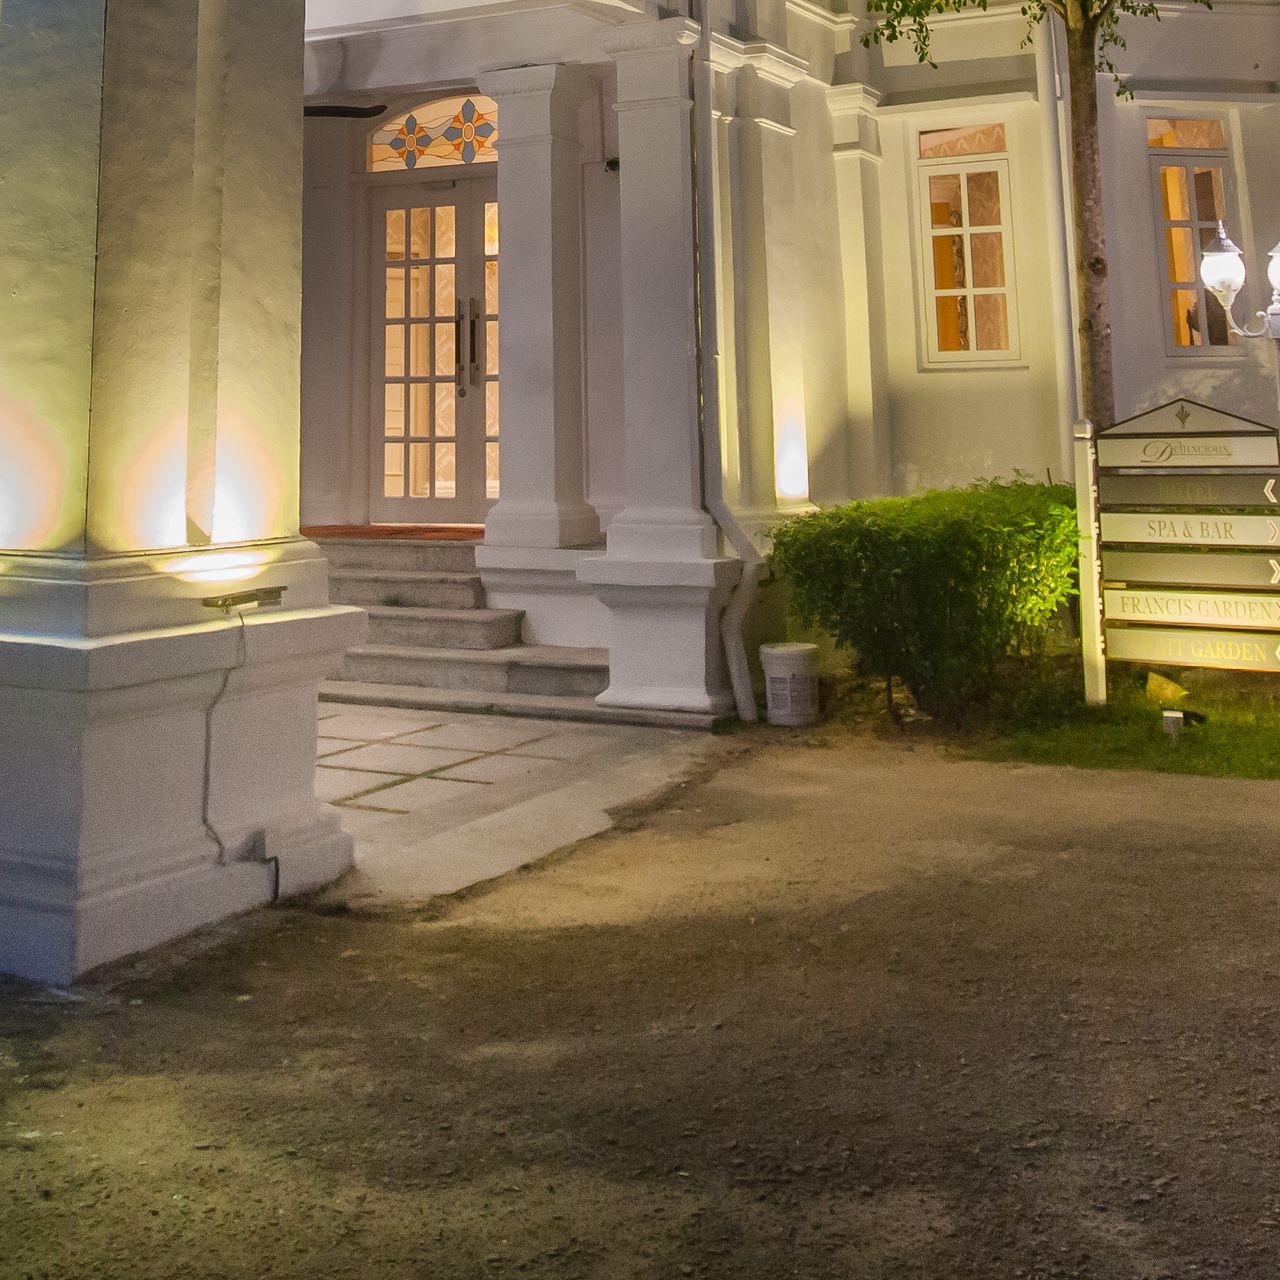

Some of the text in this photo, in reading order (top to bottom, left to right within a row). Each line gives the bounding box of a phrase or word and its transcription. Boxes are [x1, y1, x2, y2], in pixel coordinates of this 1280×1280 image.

[1147, 519, 1235, 540] SPA & BAR
[1120, 596, 1272, 621] FRANCIS GARDEN
[1191, 640, 1267, 662] GARDEN
